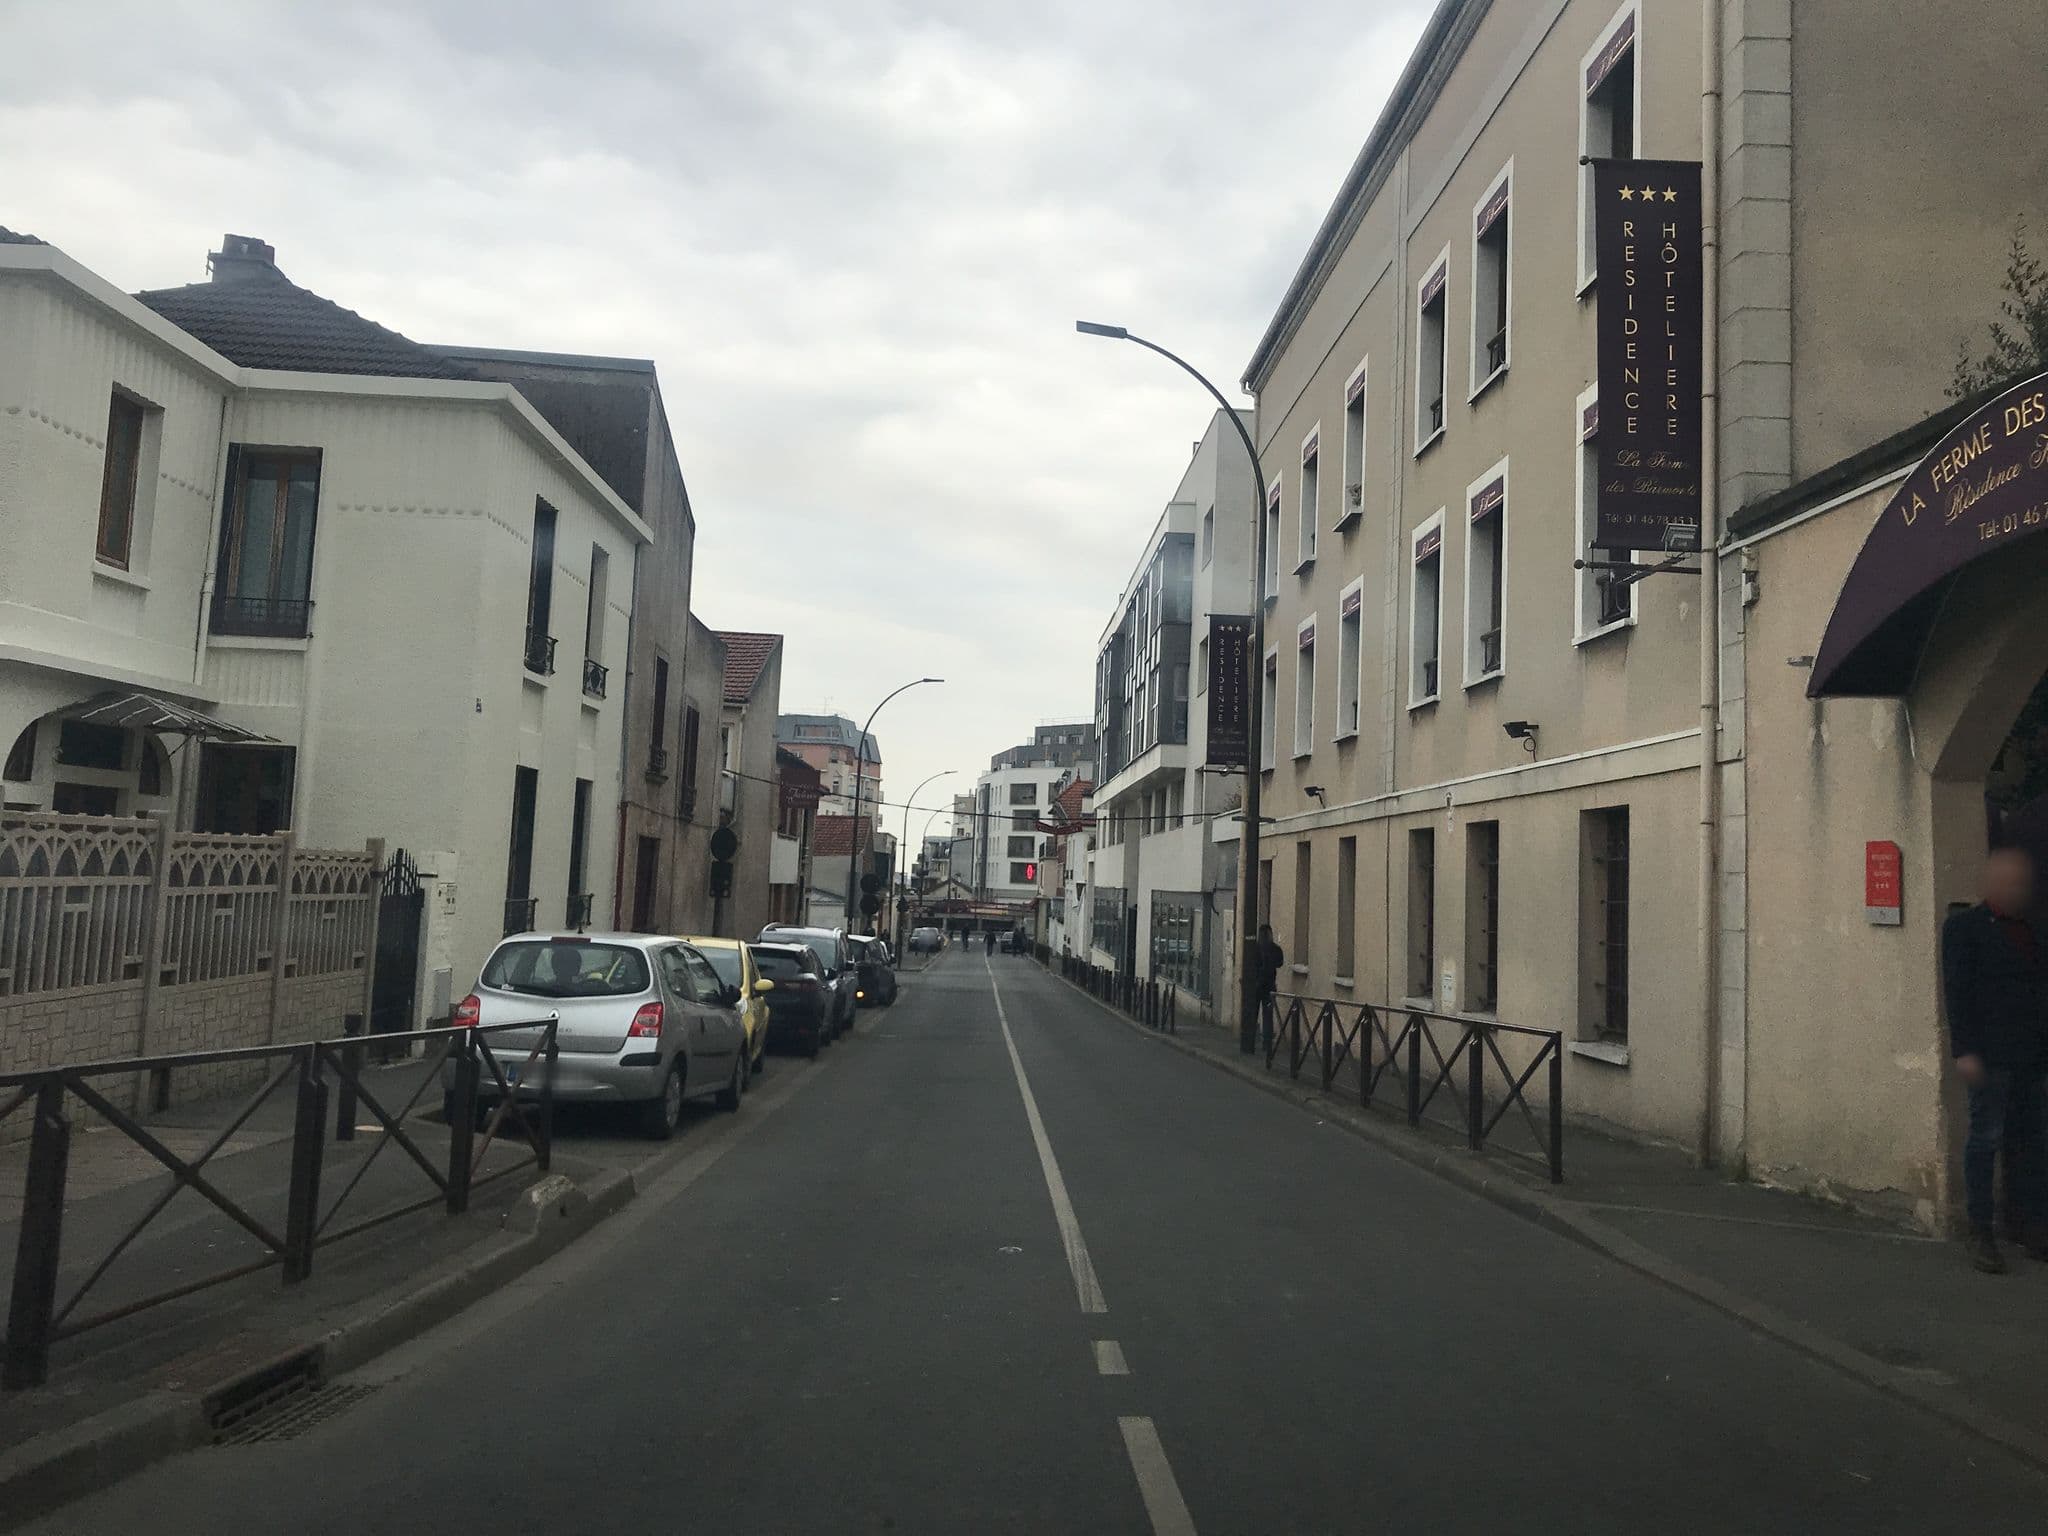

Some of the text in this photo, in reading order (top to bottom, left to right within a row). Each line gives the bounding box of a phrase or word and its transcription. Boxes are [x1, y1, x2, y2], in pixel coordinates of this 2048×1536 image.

[1623, 221, 1640, 434] RESIDENCE
[1661, 222, 1678, 435] HÔTELIERE
[1901, 492, 1926, 526] LA
[1931, 422, 1993, 493] FERME
[2004, 393, 2046, 437] DES
[1944, 463, 2022, 526] Résidence
[1641, 515, 1654, 525] 46
[1978, 517, 2000, 541] Tél:
[2003, 512, 2017, 533] 01
[2022, 504, 2041, 525] 46
